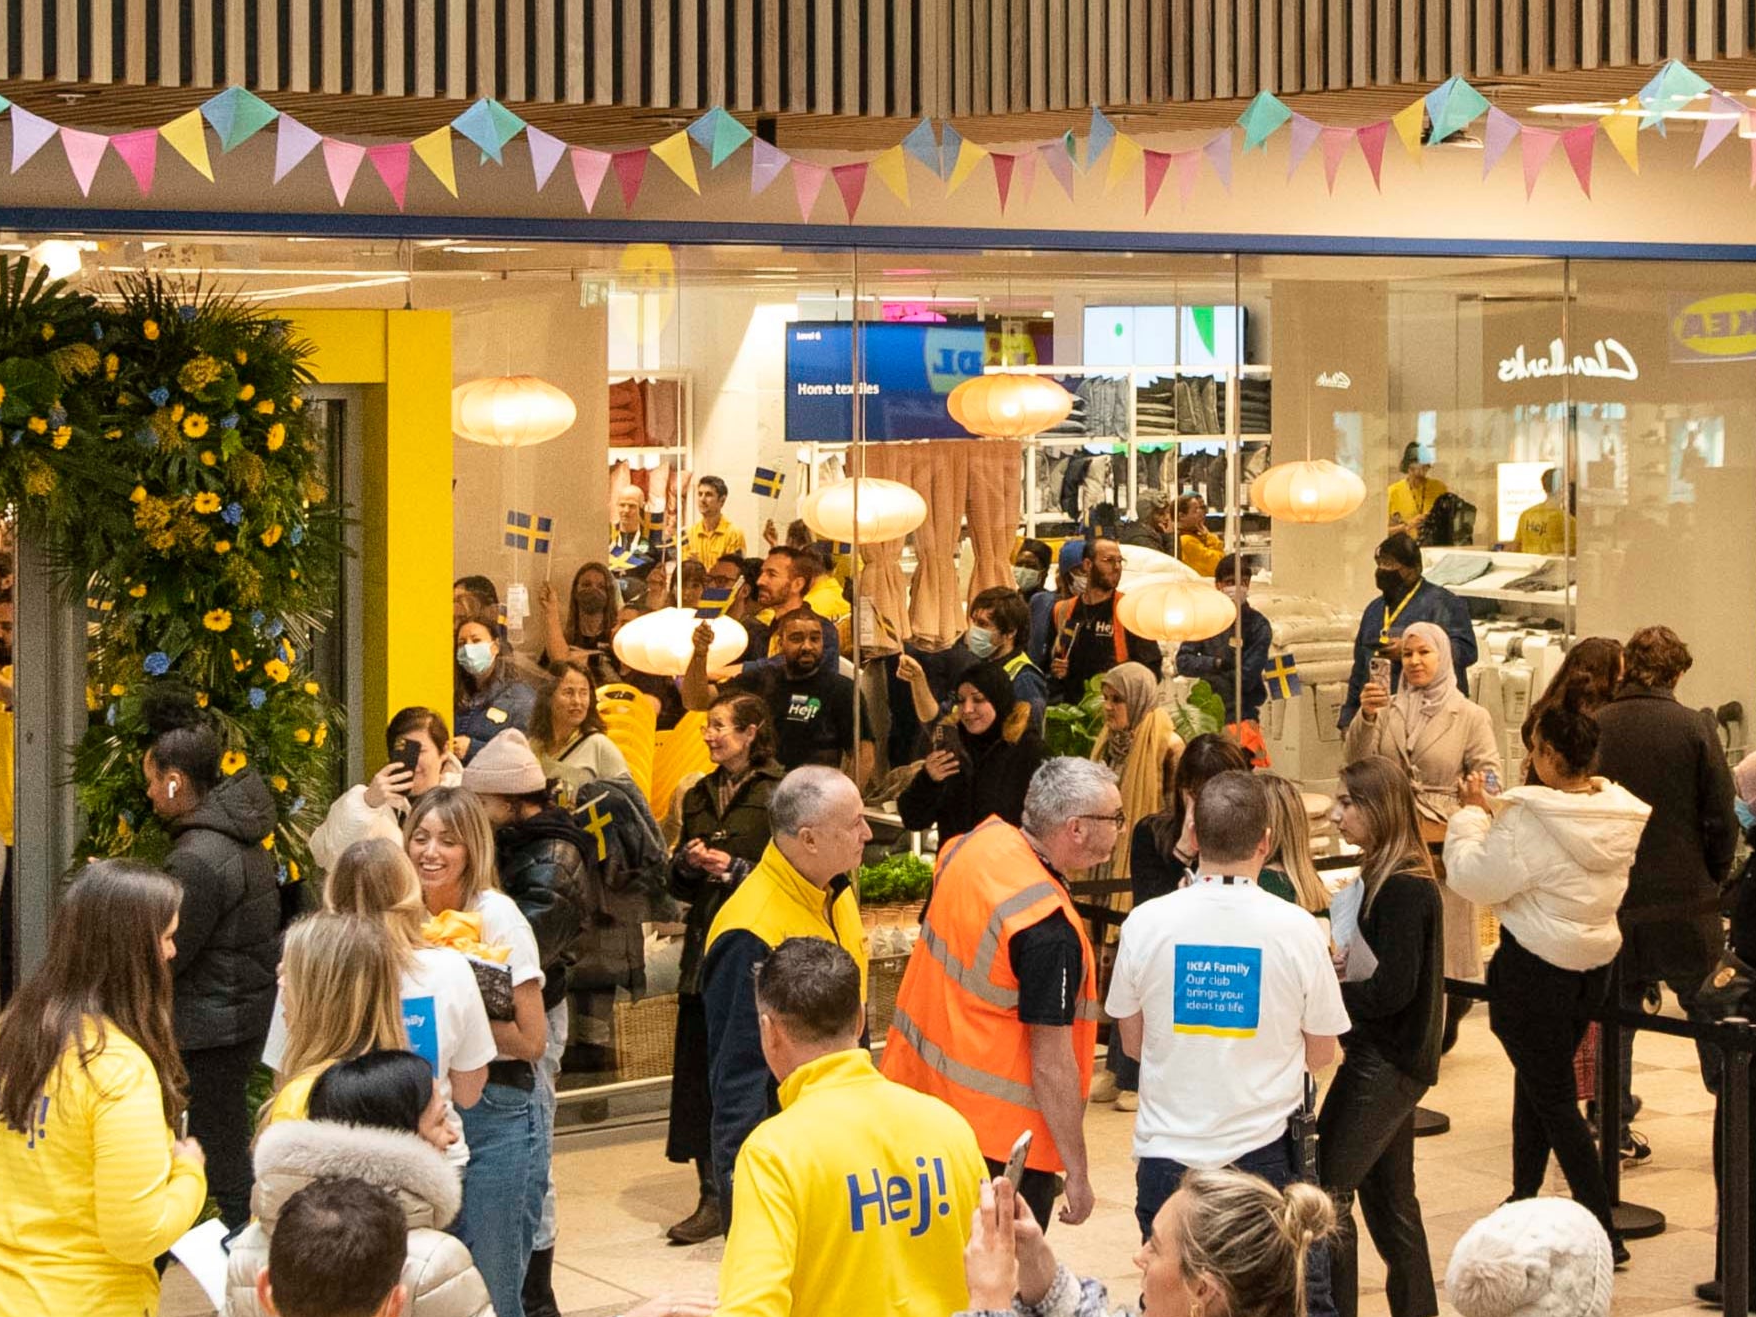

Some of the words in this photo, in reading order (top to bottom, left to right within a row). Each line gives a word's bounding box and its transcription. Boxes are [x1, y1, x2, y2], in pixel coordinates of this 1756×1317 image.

[797, 383, 833, 395] Home
[835, 382, 880, 395] texiles
[788, 703, 819, 720] Hej!
[1186, 961, 1211, 972] IKEA
[1214, 962, 1250, 977] Family
[1186, 973, 1206, 984] Our
[1209, 974, 1230, 986] club
[1186, 988, 1218, 1000] brings
[1220, 991, 1244, 1001] your
[1215, 1002, 1225, 1011] to
[1227, 1001, 1245, 1013] life
[847, 1155, 949, 1238] Hej!
